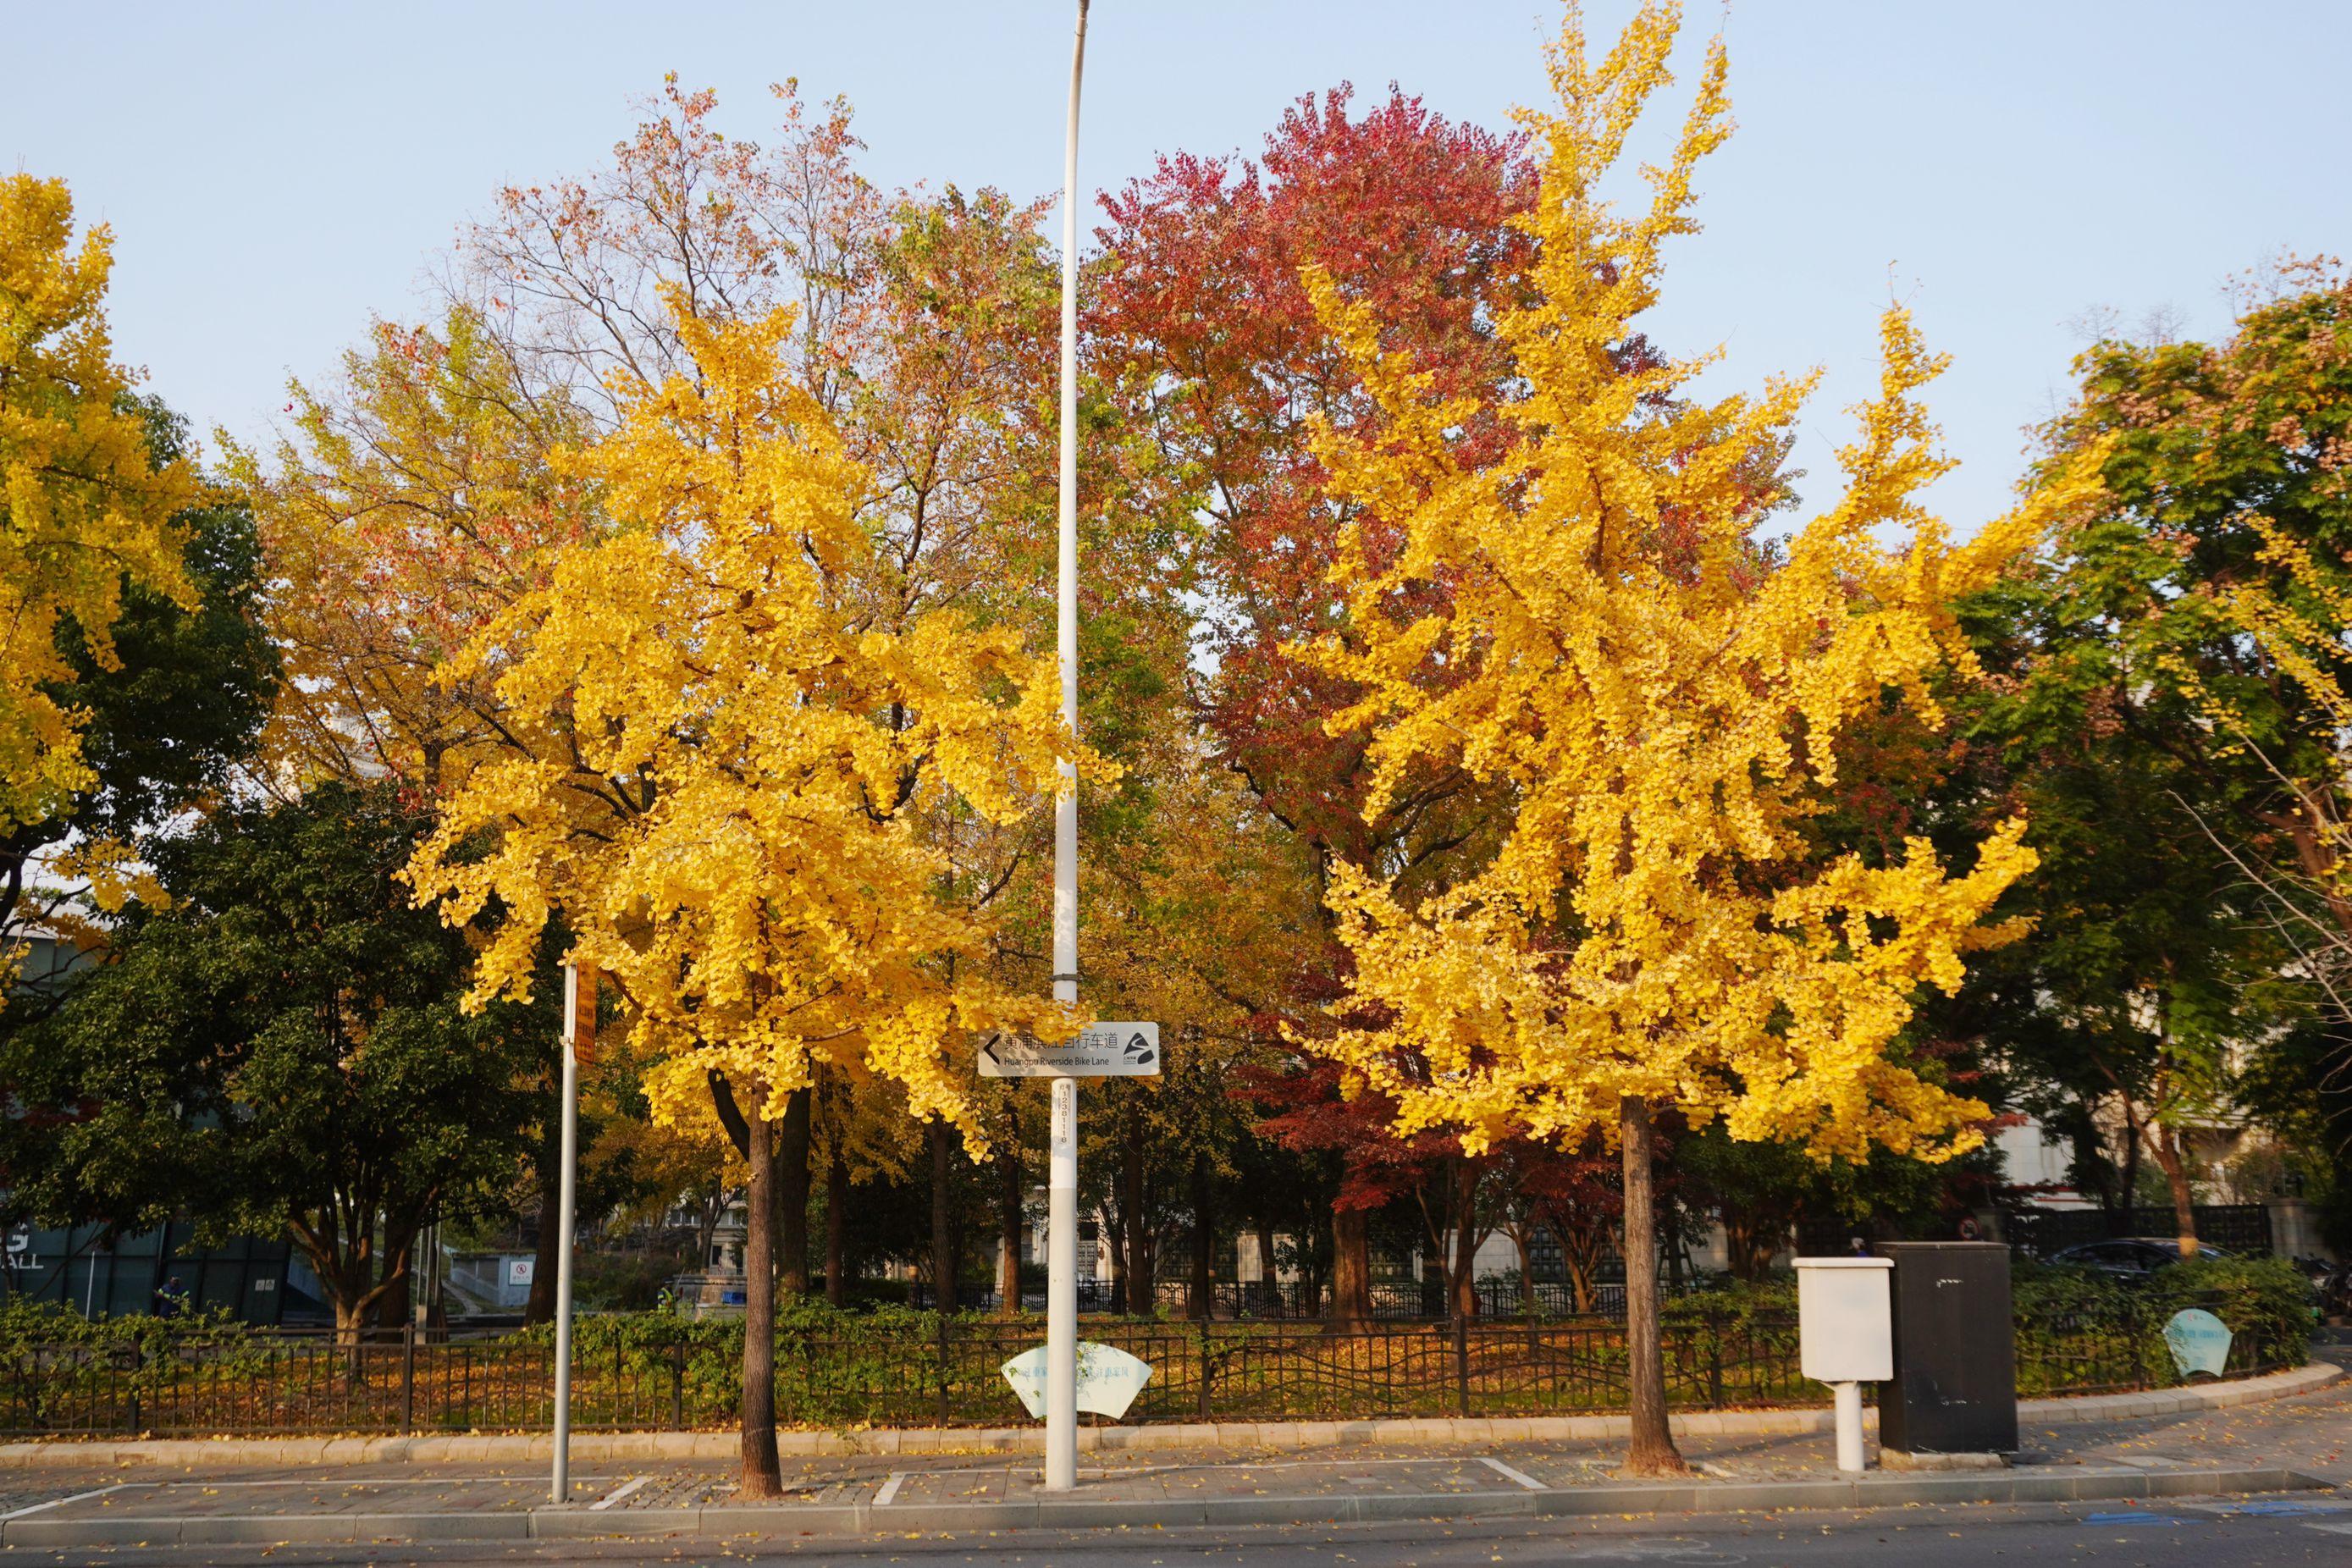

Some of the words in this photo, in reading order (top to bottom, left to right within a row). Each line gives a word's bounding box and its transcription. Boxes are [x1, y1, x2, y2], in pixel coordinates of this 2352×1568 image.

[1004, 1057, 1039, 1068] Huangpu
[1041, 1057, 1073, 1066] Riverside
[1074, 1057, 1090, 1066] Bike
[1091, 1057, 1109, 1066] Lane
[0, 1253, 44, 1269] ALL
